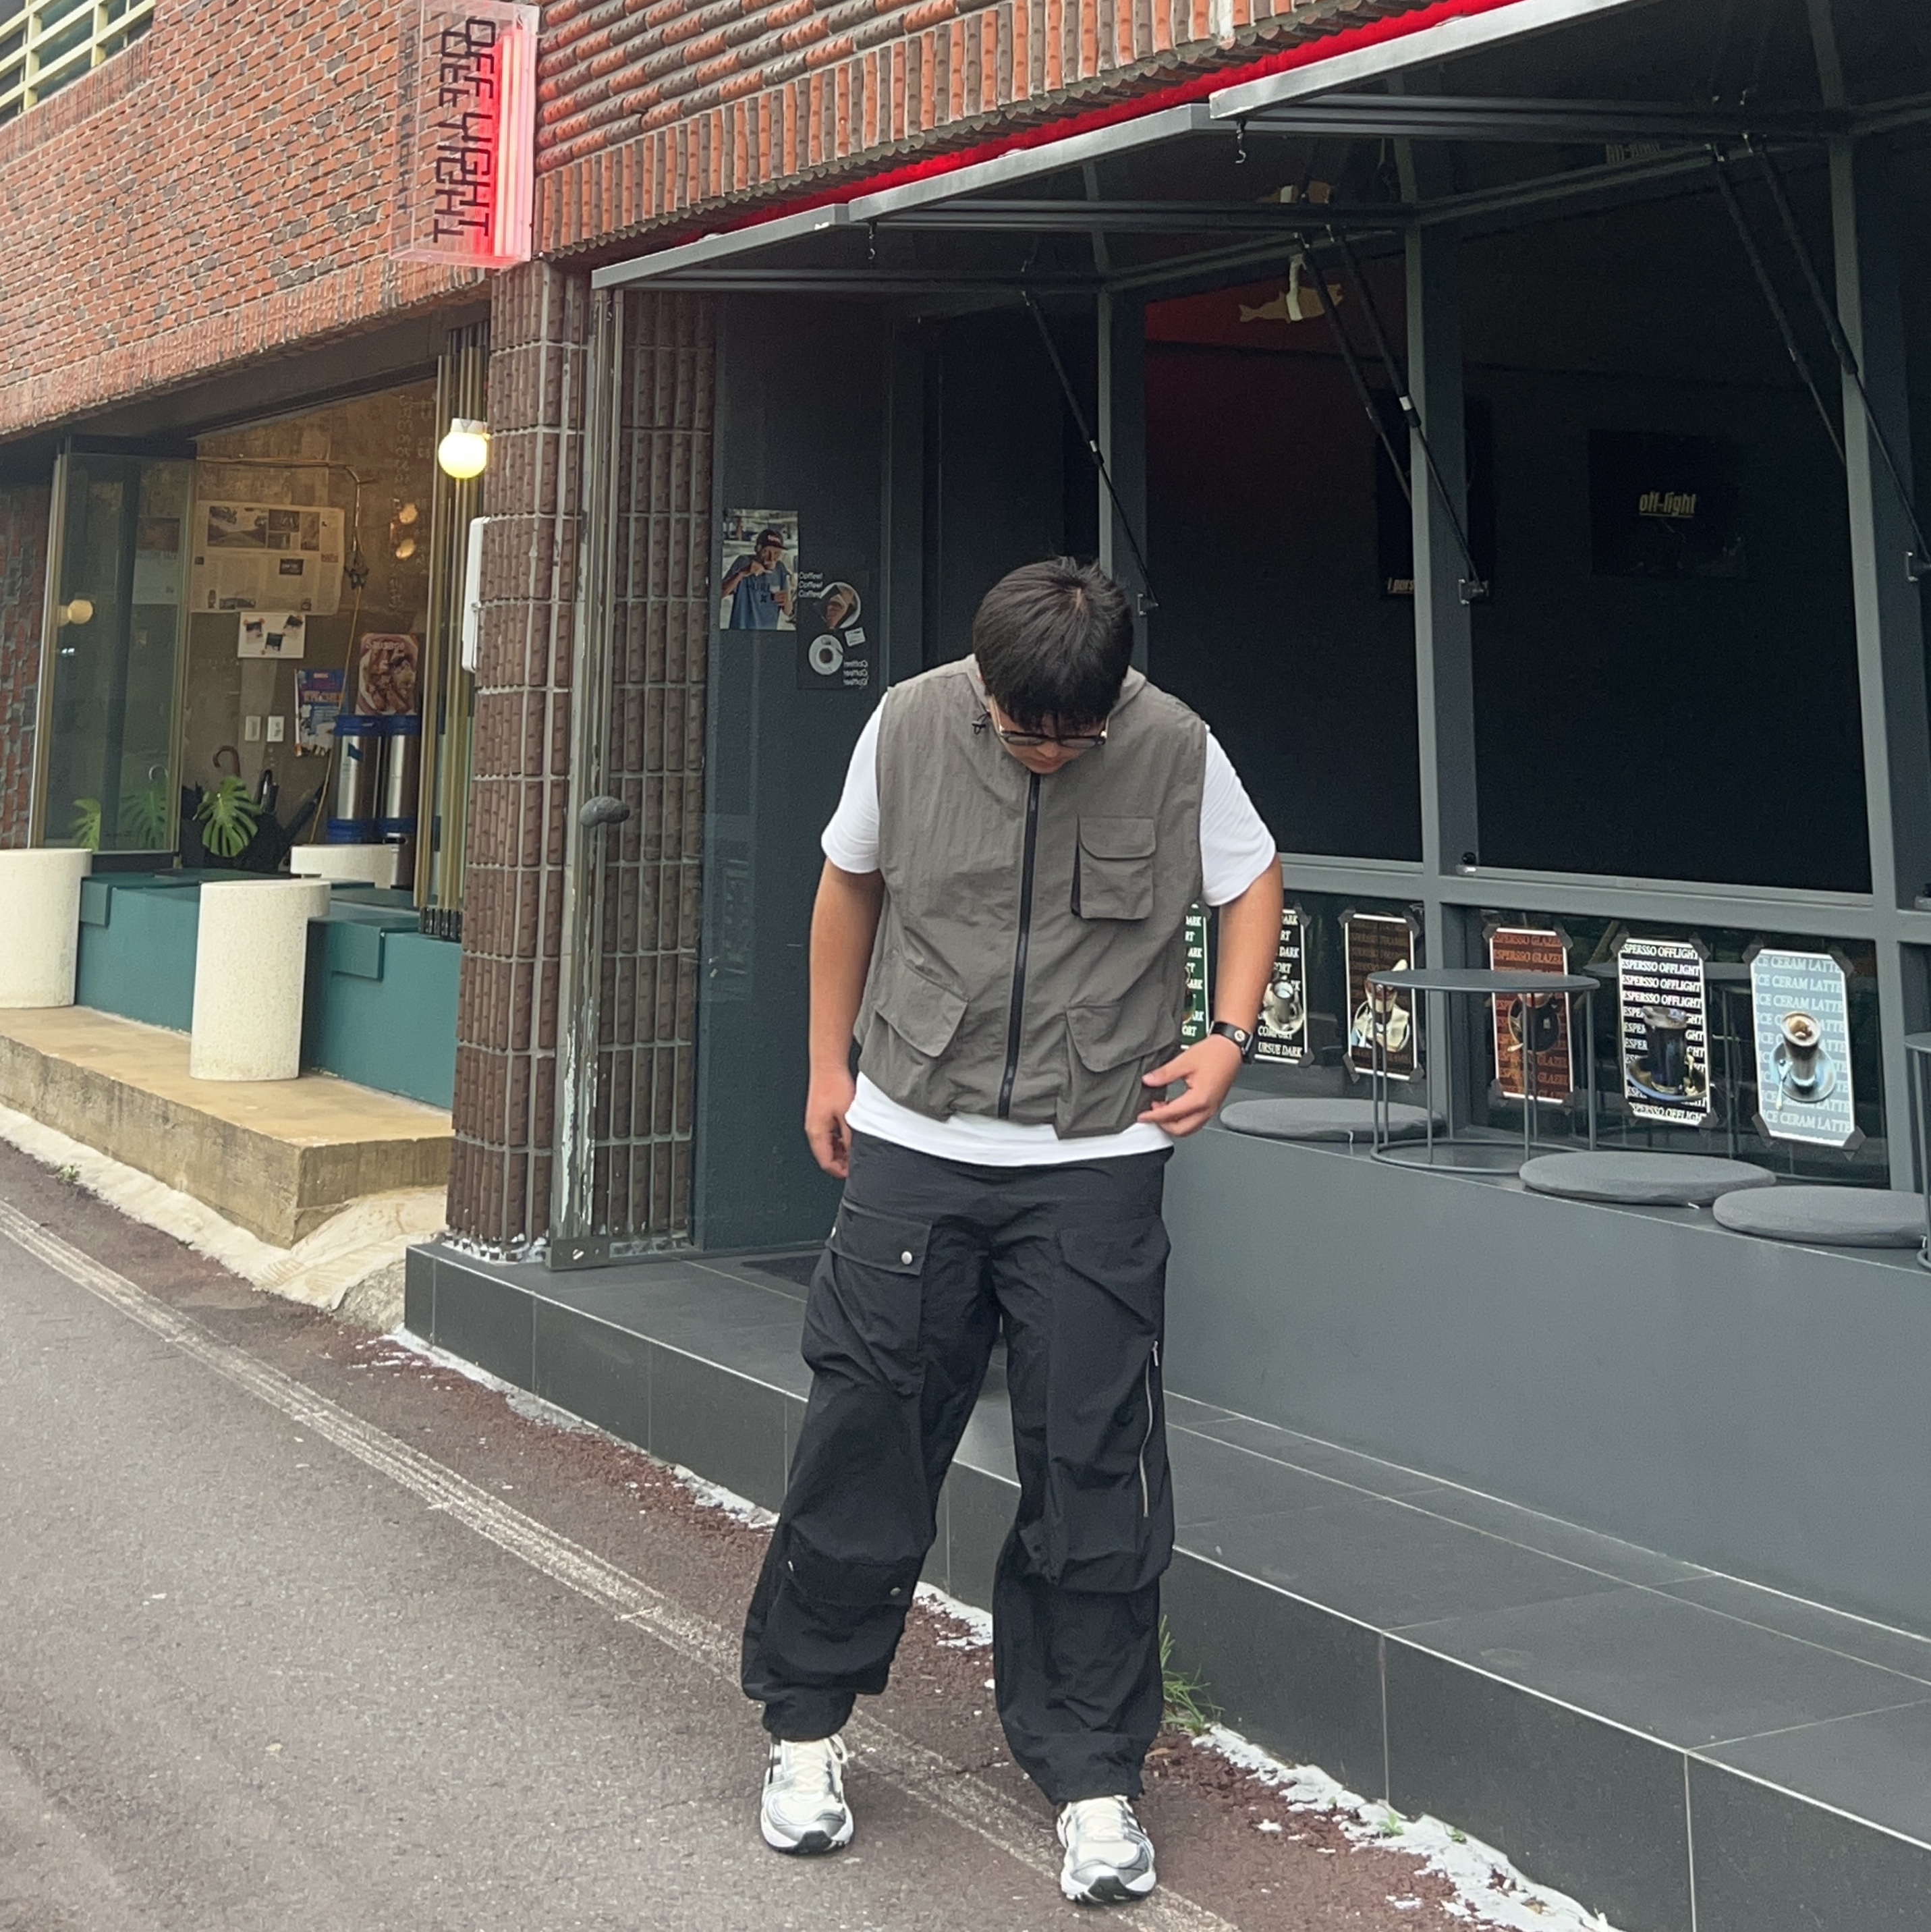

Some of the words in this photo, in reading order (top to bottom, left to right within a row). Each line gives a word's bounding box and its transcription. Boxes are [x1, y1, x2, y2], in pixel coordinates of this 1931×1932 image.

[465, 18, 496, 99] OFF
[458, 111, 493, 237] LIGHT
[1639, 491, 1697, 517] off-light
[1187, 947, 1203, 958] ARK
[1279, 946, 1300, 958] DARK
[1621, 943, 1656, 956] SPERSSO
[1659, 962, 1700, 976] OFFLIGHT
[1771, 956, 1806, 970] CERAM
[1187, 978, 1204, 989] ARK
[1660, 978, 1701, 992] OFFLIGHT
[1772, 975, 1808, 990] CERAM
[1810, 978, 1842, 993] LATTE
[1661, 995, 1702, 1008] OFFLIGHT
[1773, 995, 1810, 1009] CERAM
[1812, 999, 1843, 1012] LATTE
[1820, 1019, 1845, 1033] ATTE
[1282, 1045, 1303, 1057] DARK
[1780, 1112, 1815, 1128] CERAM
[1817, 1117, 1851, 1133] LATTE
